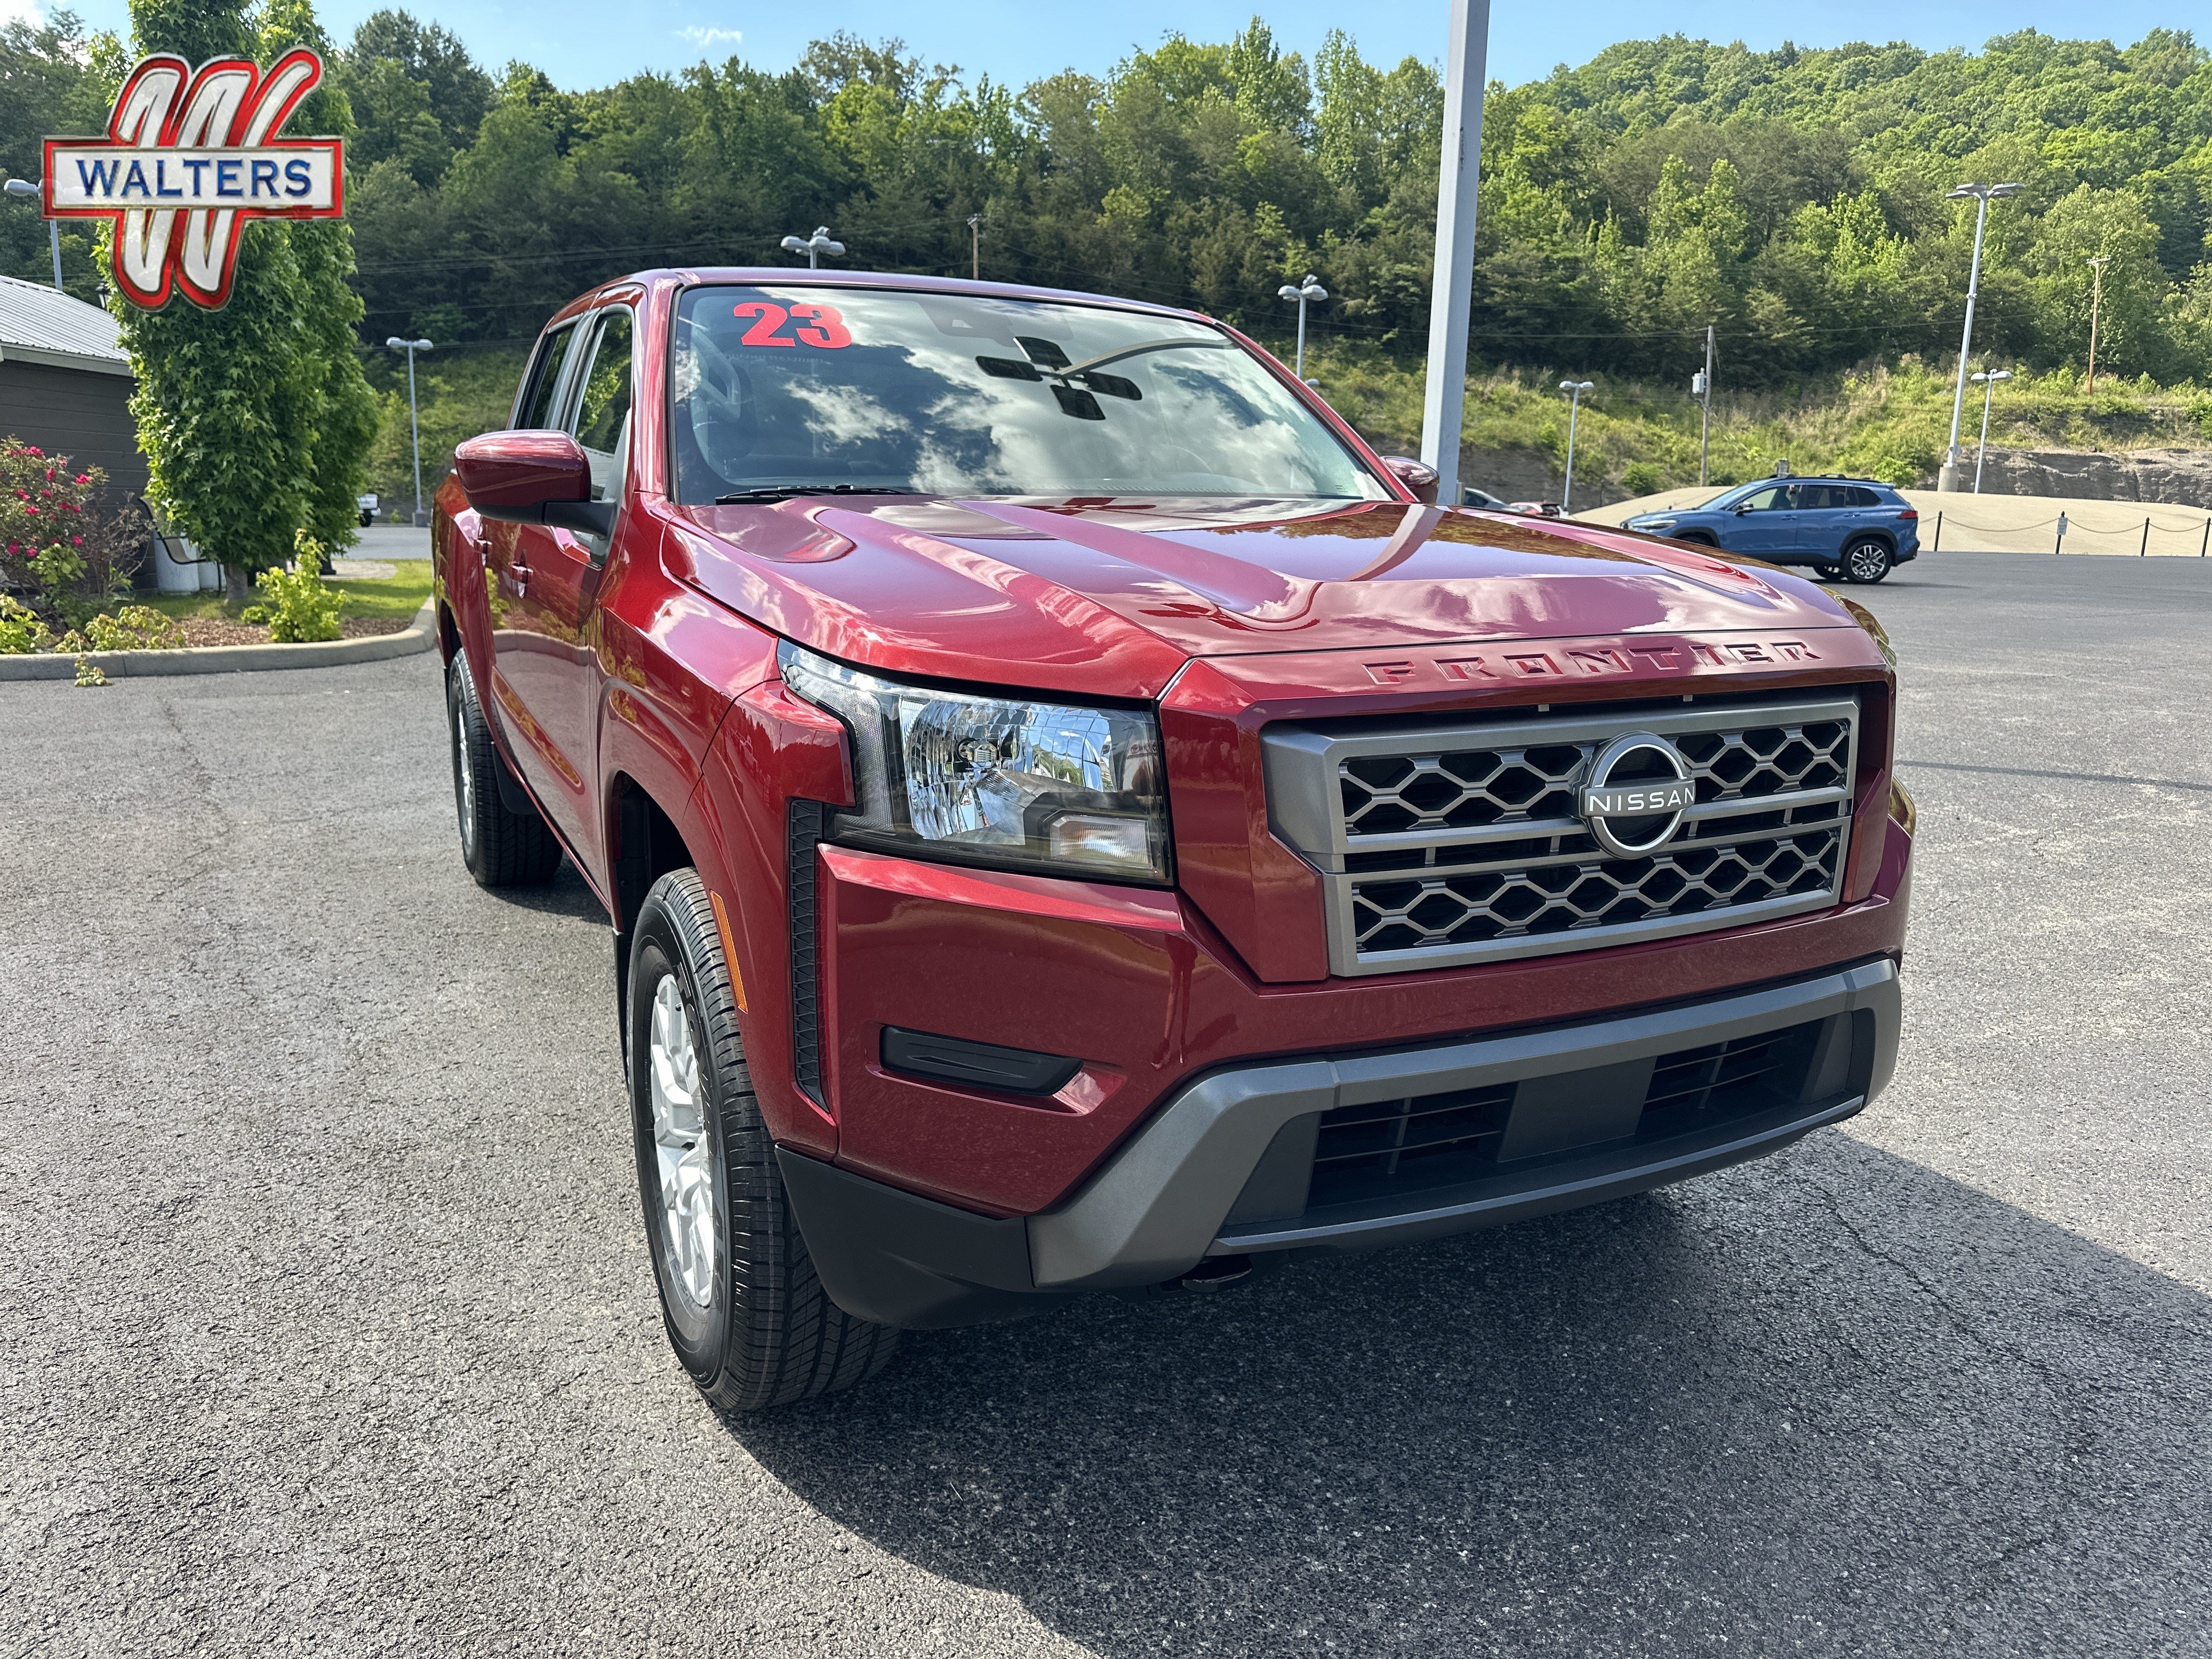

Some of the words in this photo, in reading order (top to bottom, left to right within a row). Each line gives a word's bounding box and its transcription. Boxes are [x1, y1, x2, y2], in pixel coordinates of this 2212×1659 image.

[733, 302, 852, 349] 23
[1361, 641, 1824, 685] FRONTIER
[1589, 785, 1695, 812] NISSAN
